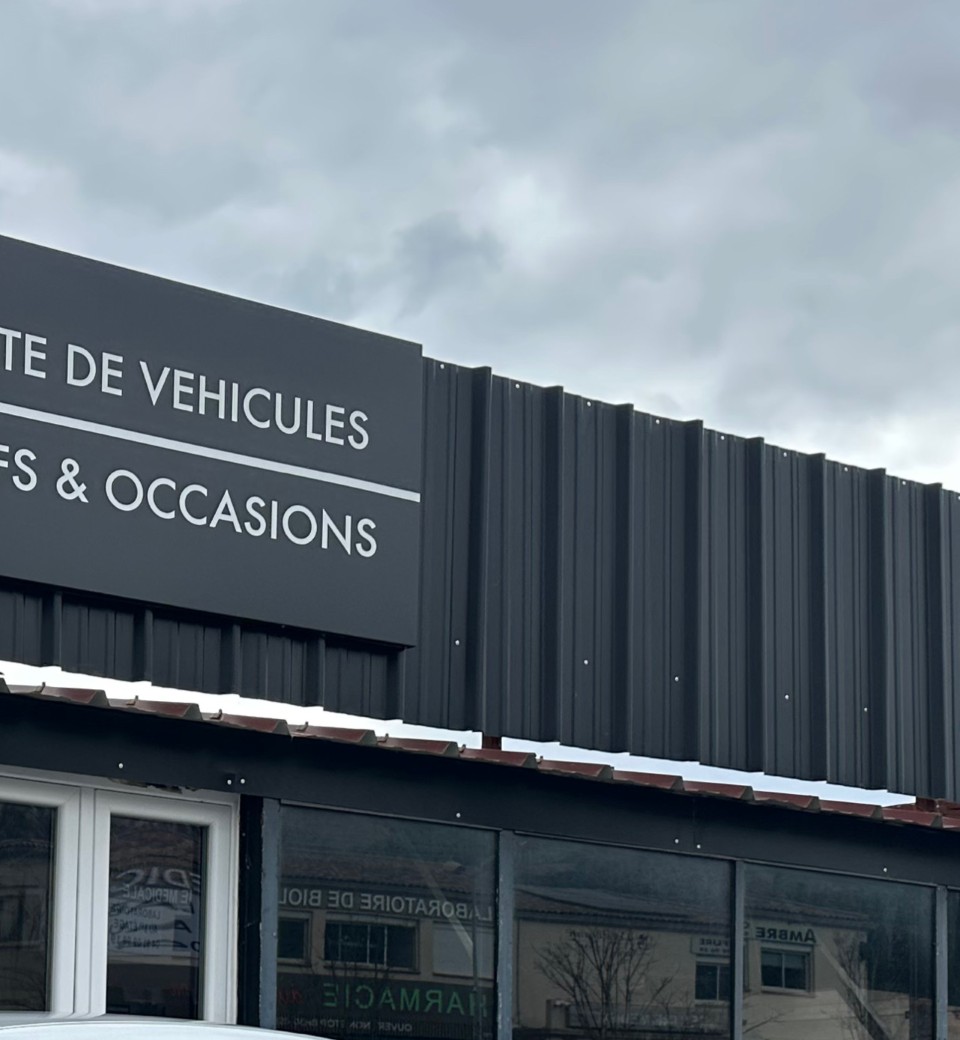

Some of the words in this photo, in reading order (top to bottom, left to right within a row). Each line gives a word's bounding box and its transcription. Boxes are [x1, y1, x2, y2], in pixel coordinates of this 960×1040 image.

[66, 343, 123, 397] DE
[140, 361, 370, 450] VEHICULES
[56, 458, 89, 503] &
[105, 469, 377, 557] OCCASIONS
